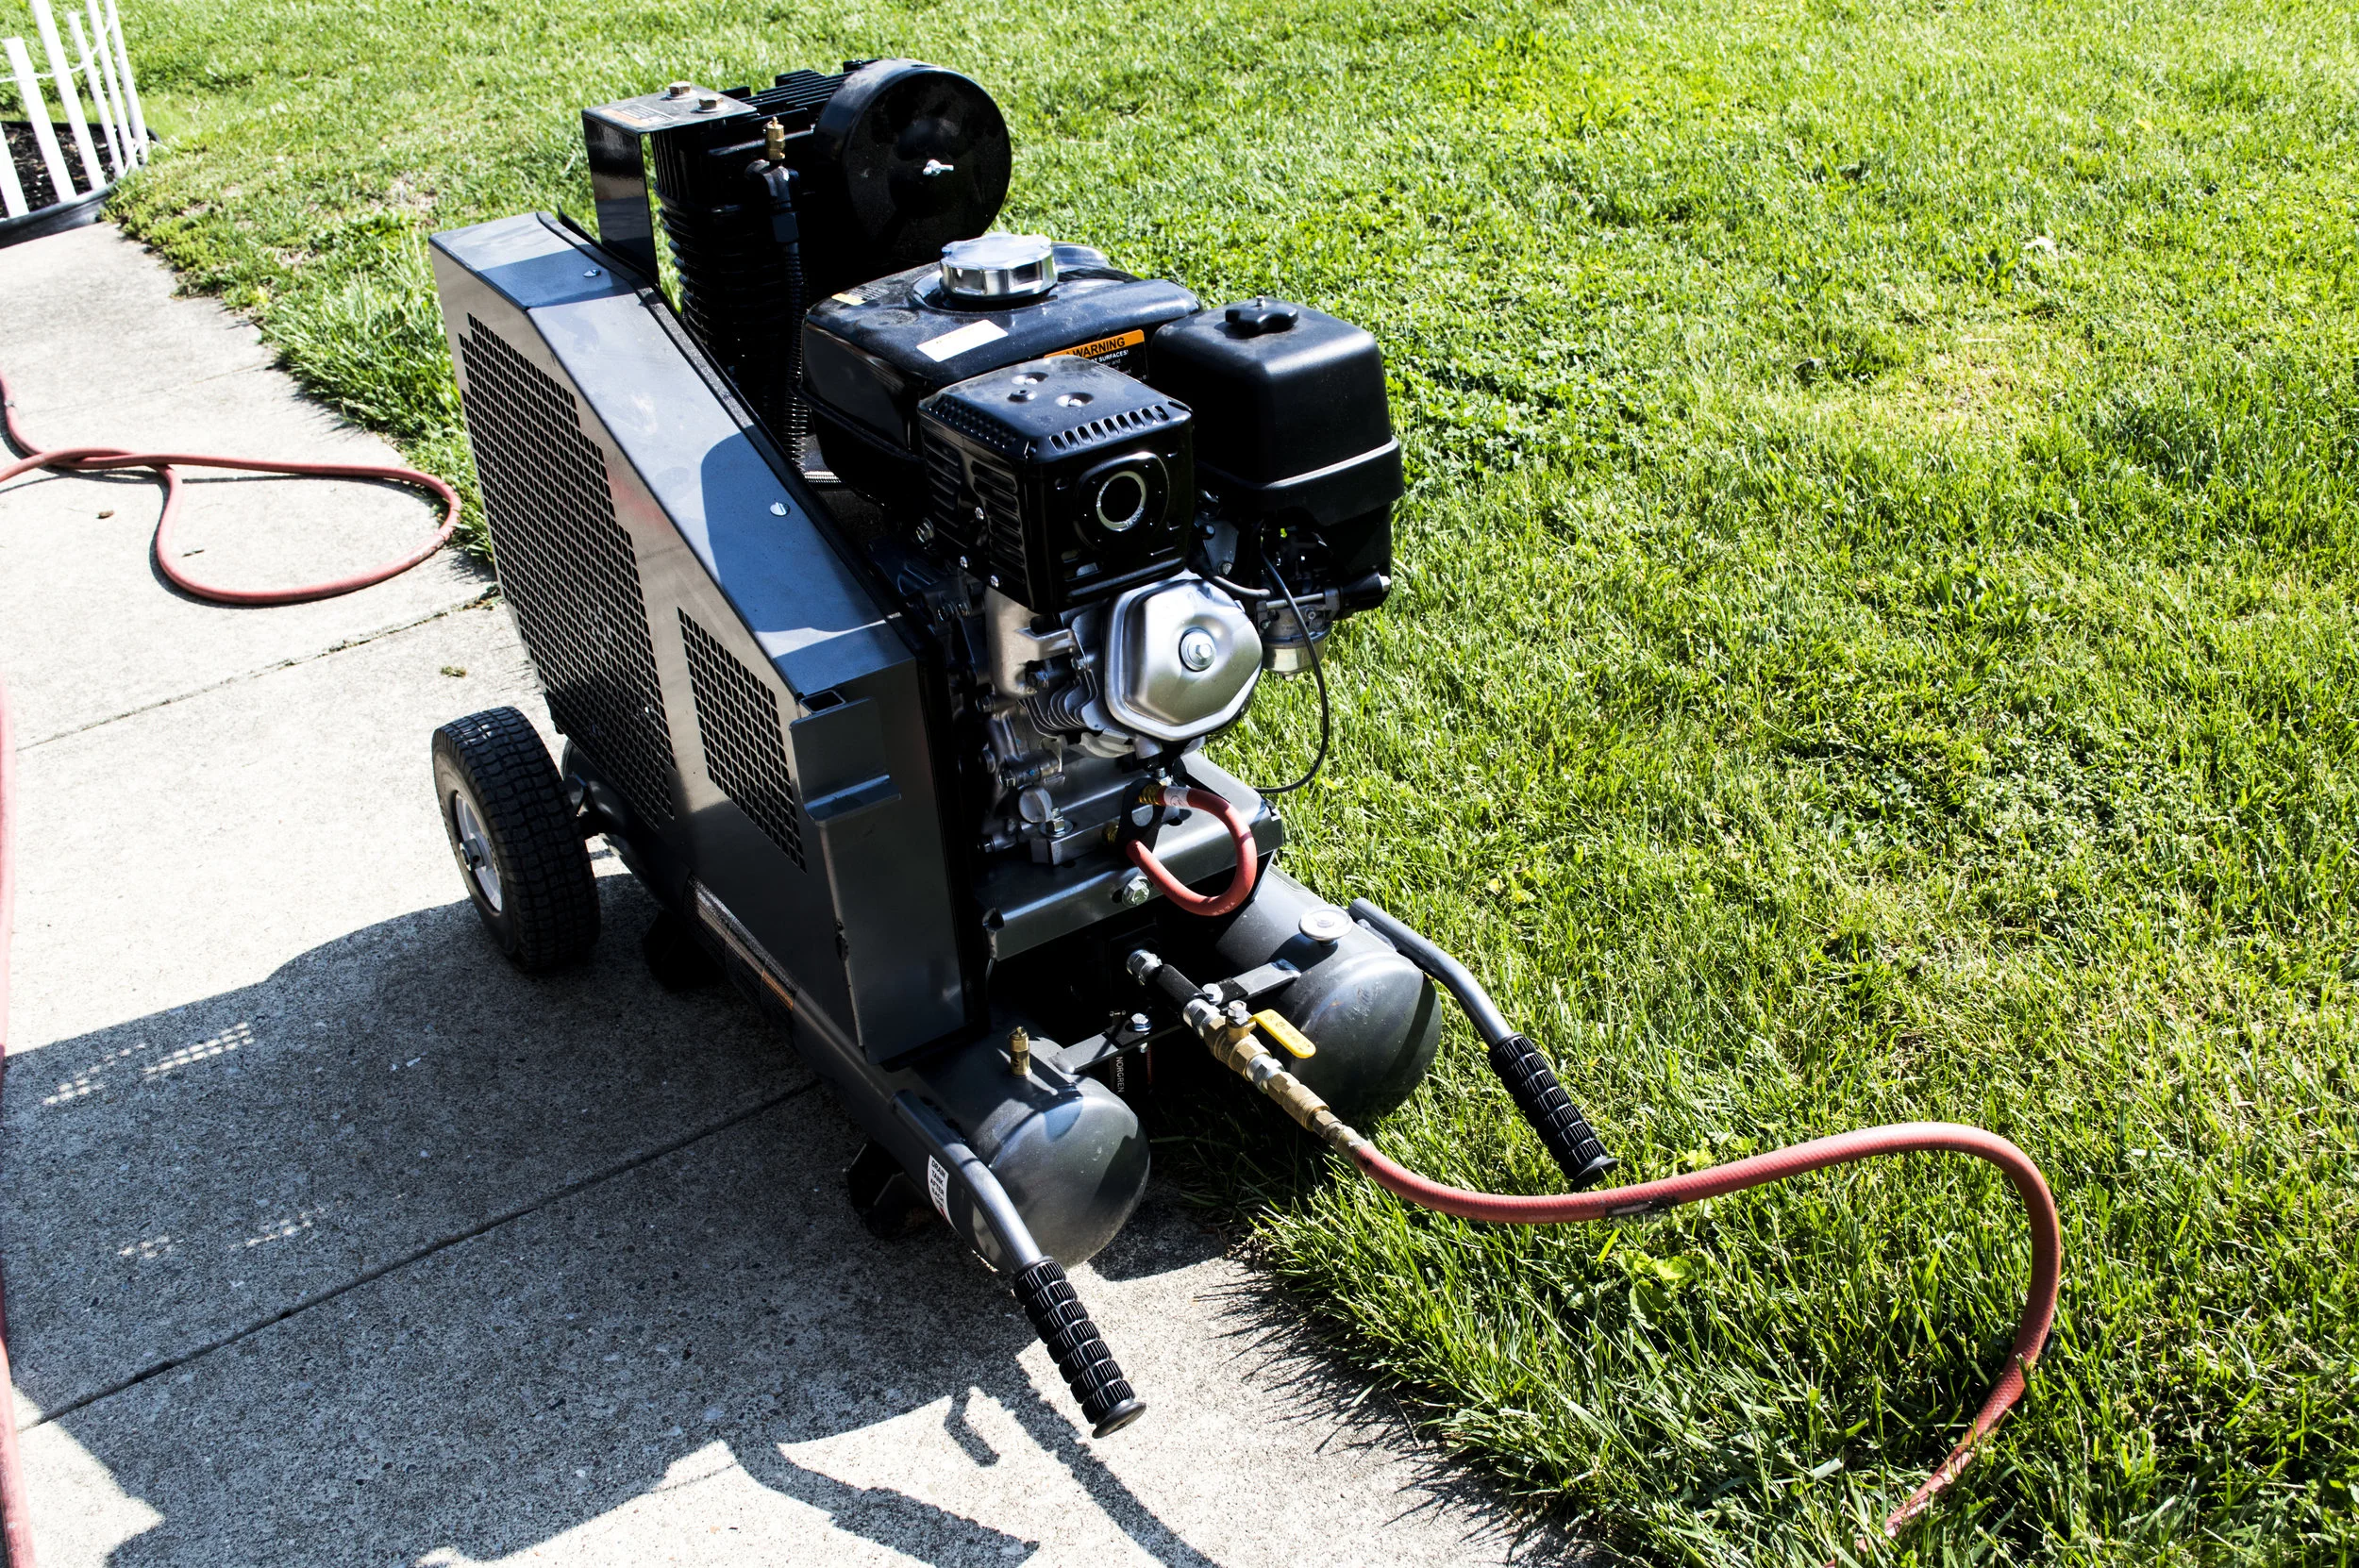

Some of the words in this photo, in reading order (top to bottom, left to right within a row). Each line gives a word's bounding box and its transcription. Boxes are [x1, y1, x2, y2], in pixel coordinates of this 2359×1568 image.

[1073, 337, 1126, 358] WARNING
[1098, 349, 1129, 363] SURFACES!
[1115, 1056, 1125, 1093] NORGREN
[930, 1169, 944, 1187] TANK
[931, 1159, 945, 1178] DRAIN
